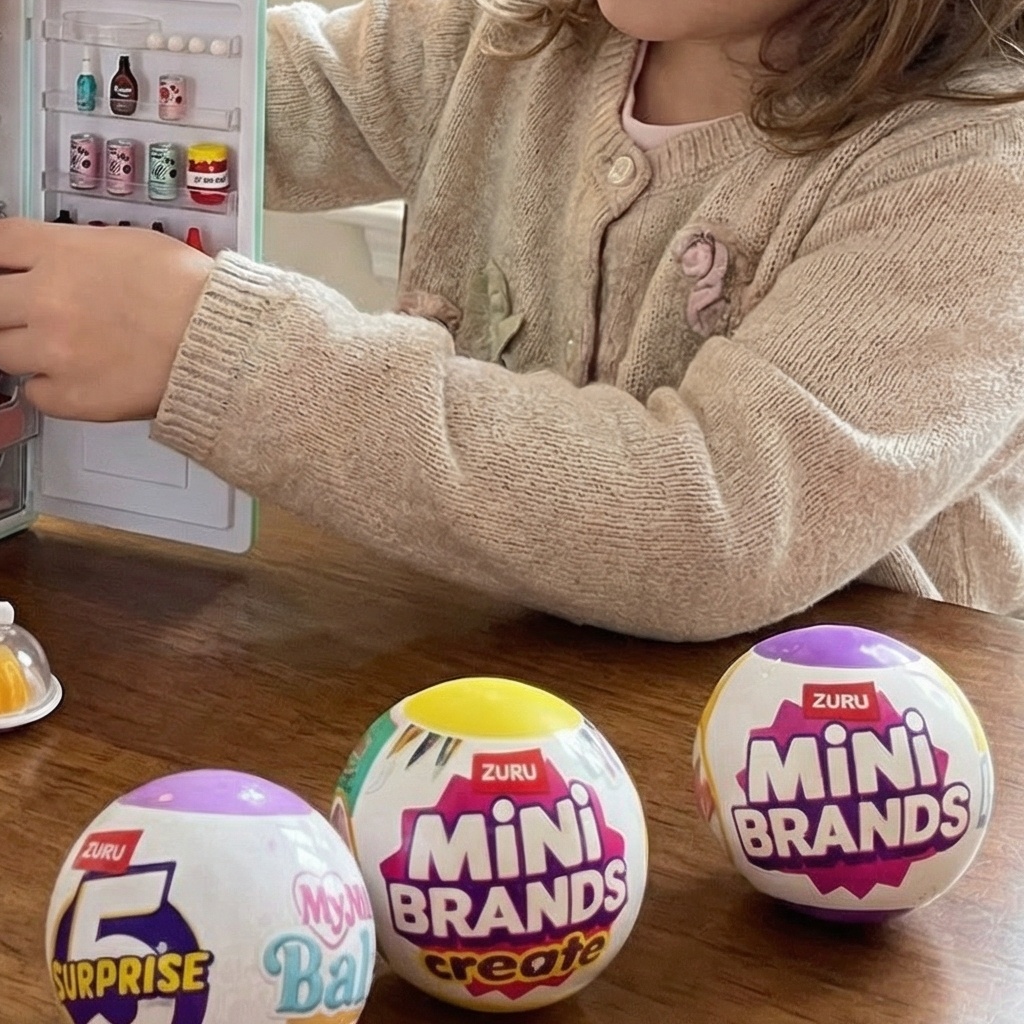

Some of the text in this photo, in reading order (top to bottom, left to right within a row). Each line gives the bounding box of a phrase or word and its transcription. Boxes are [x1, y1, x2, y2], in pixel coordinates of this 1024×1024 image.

[812, 693, 869, 710] ZURU
[481, 762, 537, 782] ZURU
[734, 785, 970, 858] BRANDS
[82, 840, 126, 862] ZURU
[389, 858, 627, 938] BRANDS
[52, 952, 210, 1001] SURPRISE
[425, 934, 608, 981] create
